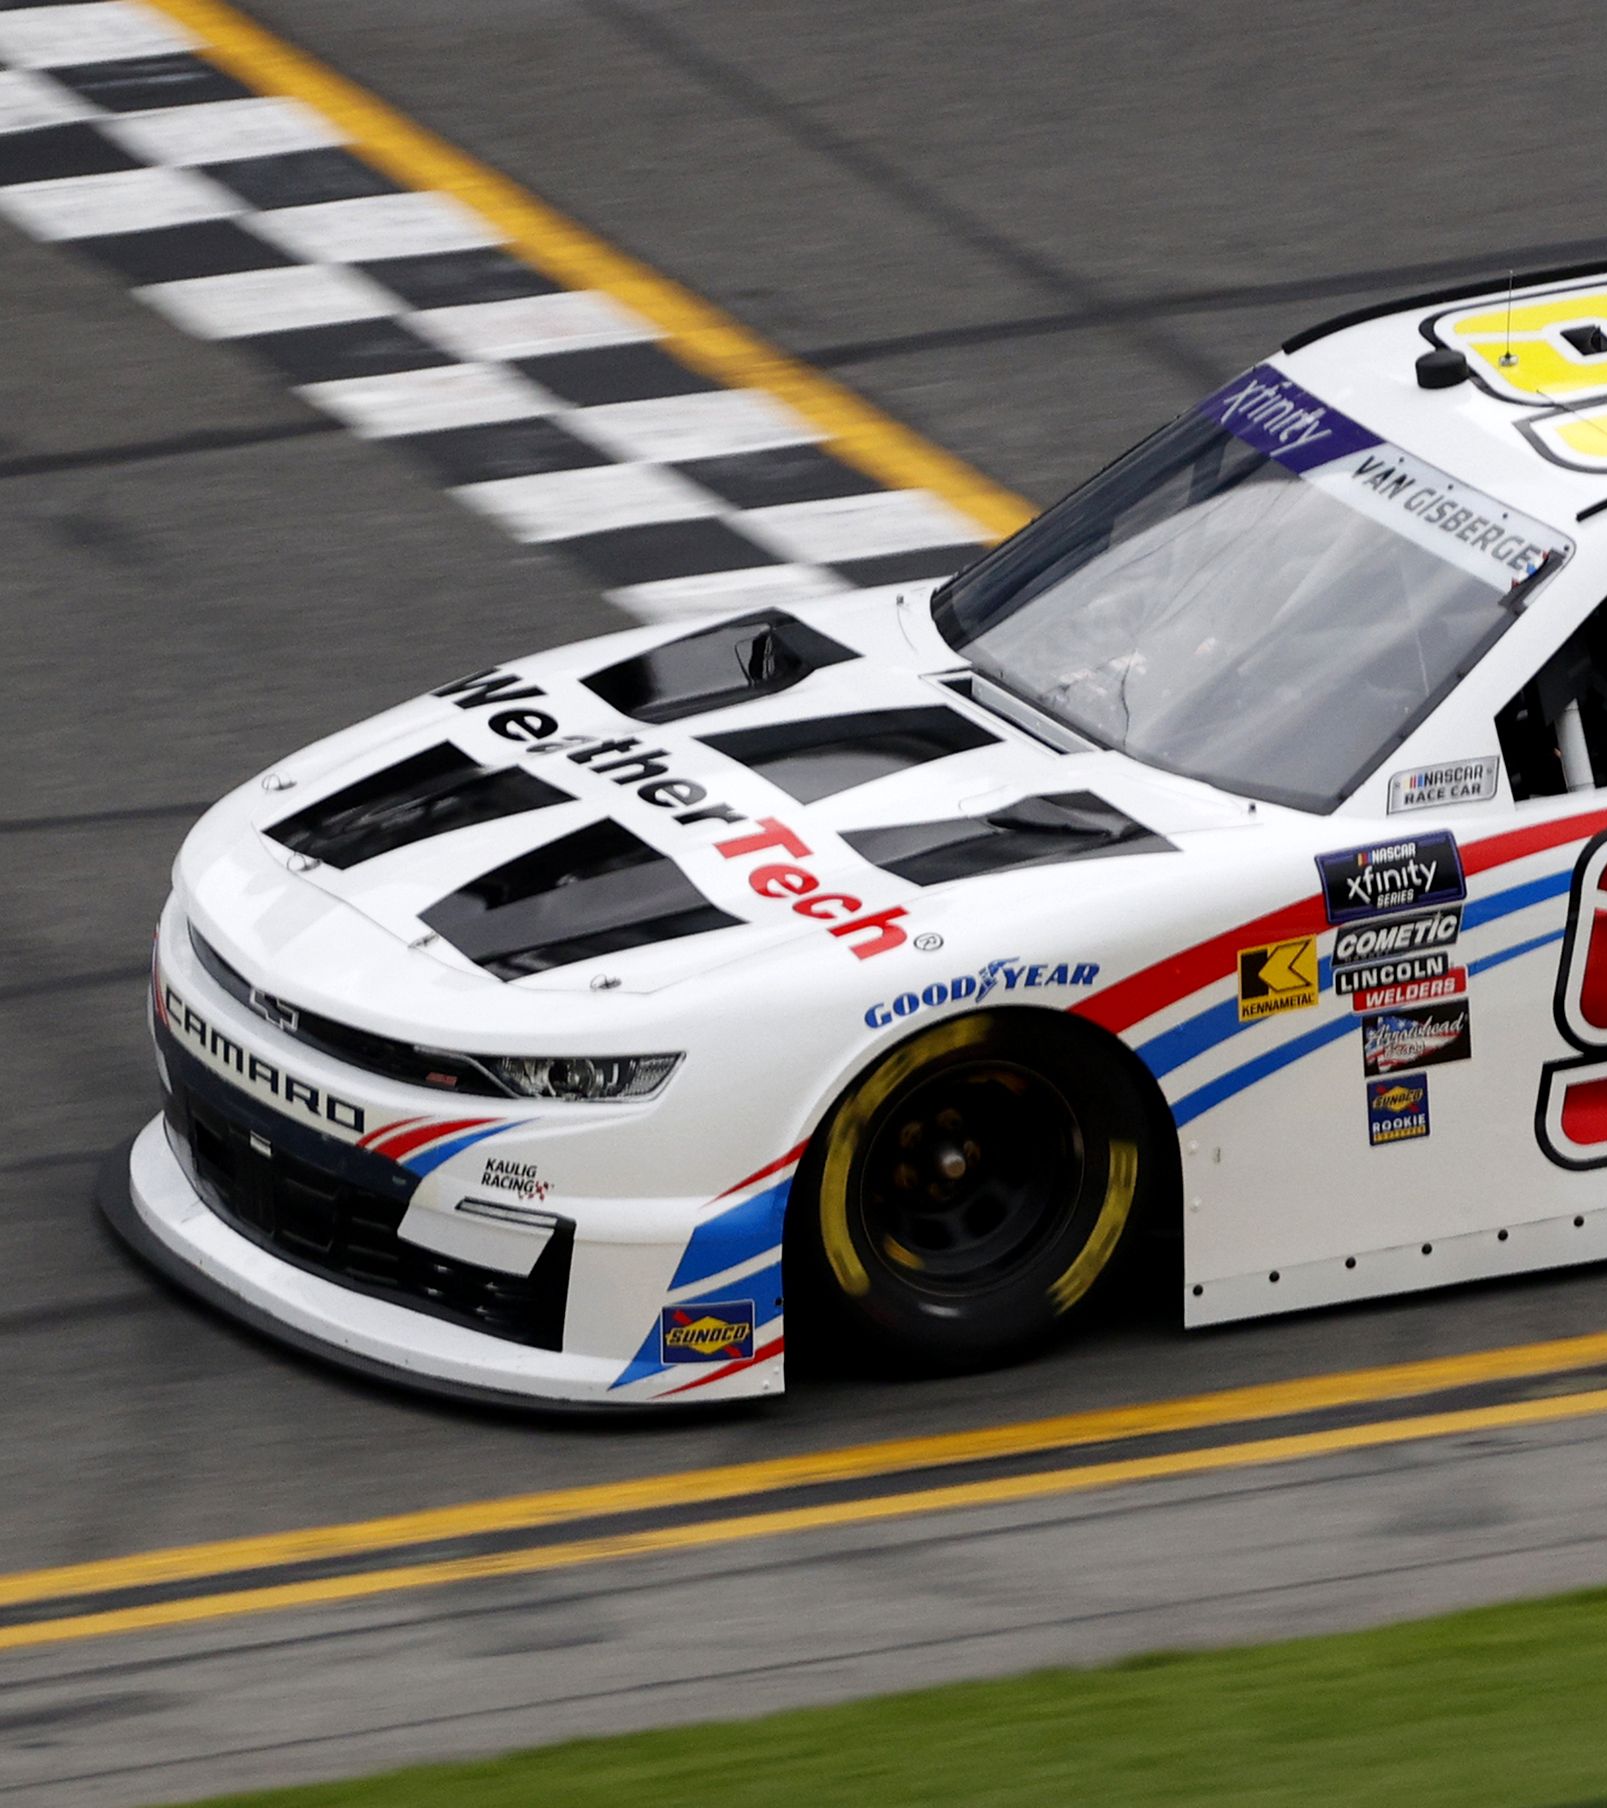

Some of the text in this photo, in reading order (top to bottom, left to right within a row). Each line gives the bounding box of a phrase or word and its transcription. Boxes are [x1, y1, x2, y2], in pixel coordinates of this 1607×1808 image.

[1220, 379, 1332, 457] xfinity
[1352, 455, 1416, 499] VAN
[1423, 764, 1483, 788] NASCAR
[1404, 782, 1482, 805] RACE CAR
[1371, 842, 1416, 864] NASCAR
[1346, 859, 1437, 904] xfinity
[1376, 888, 1414, 909] SERIES
[1336, 912, 1458, 960] COMETIC
[1340, 956, 1443, 992] LINCOLN
[1366, 977, 1456, 1008] WELDERS
[1242, 993, 1312, 1017] KENNAMETAL
[1365, 1011, 1464, 1050] Arrowhead
[166, 984, 365, 1134] CAMARO
[1373, 1088, 1423, 1110] SUNOCO
[1373, 1113, 1426, 1134] ROOKIE
[485, 1158, 538, 1179] KAULIG
[481, 1171, 534, 1194] RACING
[668, 1323, 749, 1345] SUNOCO
